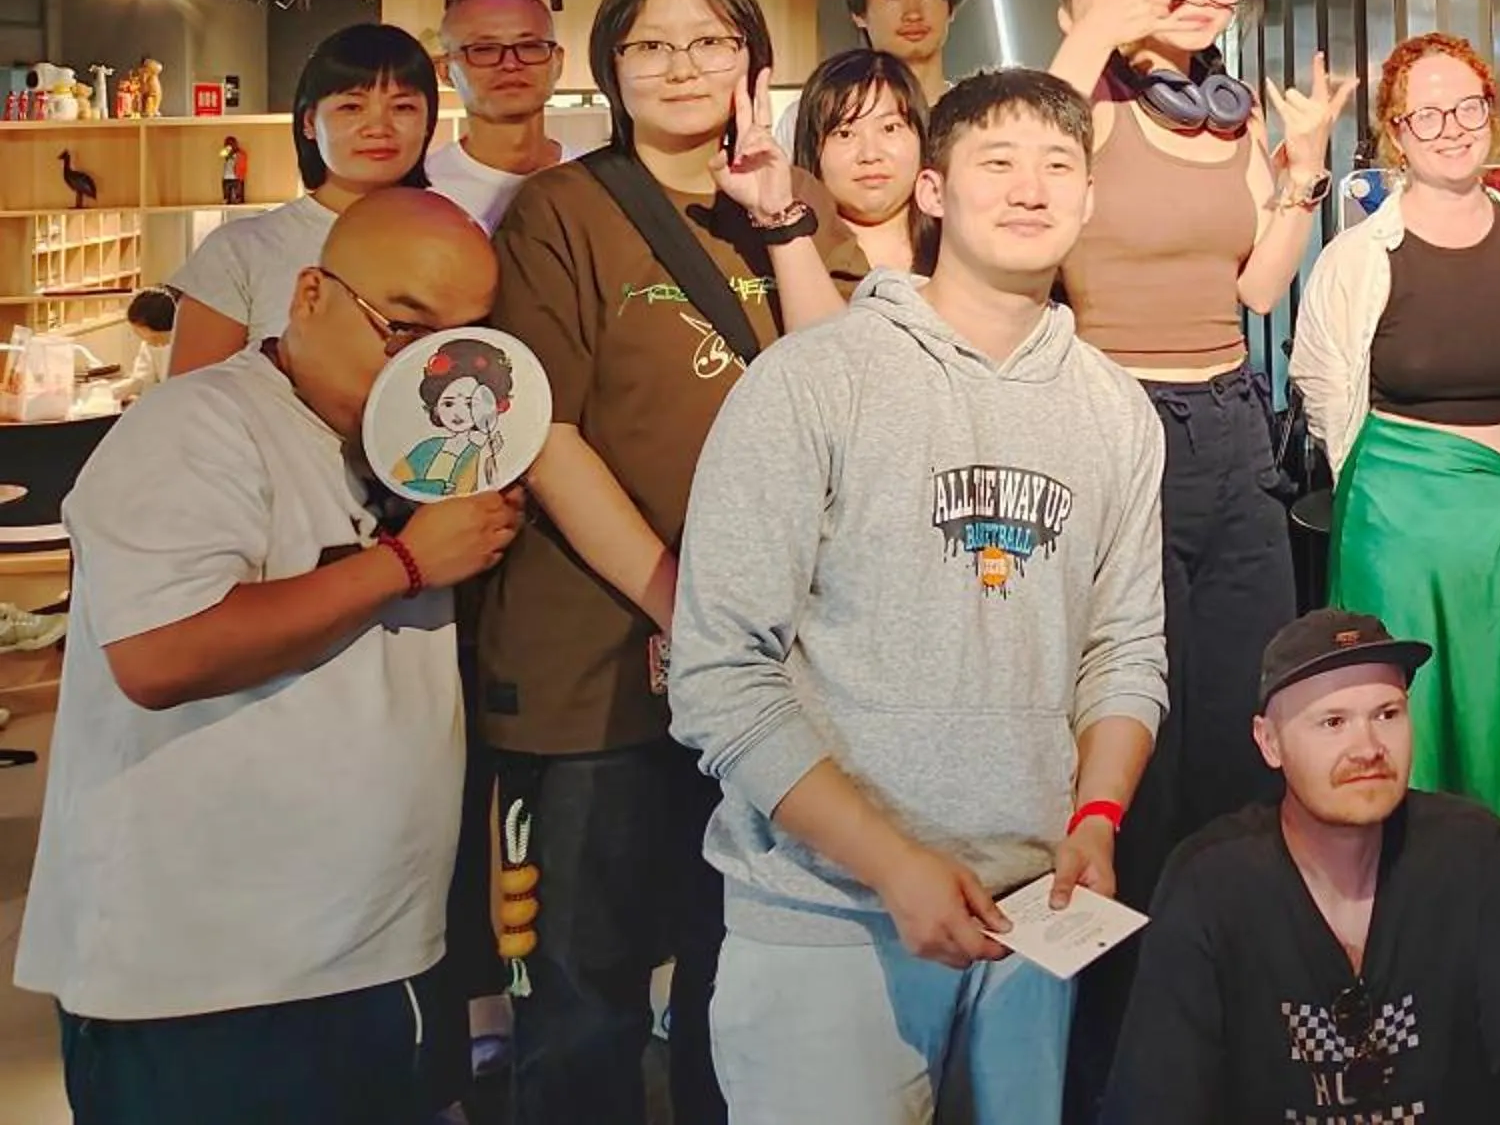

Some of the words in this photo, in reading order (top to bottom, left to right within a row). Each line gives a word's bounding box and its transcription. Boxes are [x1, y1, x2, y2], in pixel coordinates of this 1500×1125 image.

[935, 469, 974, 525] ALL
[999, 469, 1046, 523] WAY
[1043, 479, 1071, 533] UP
